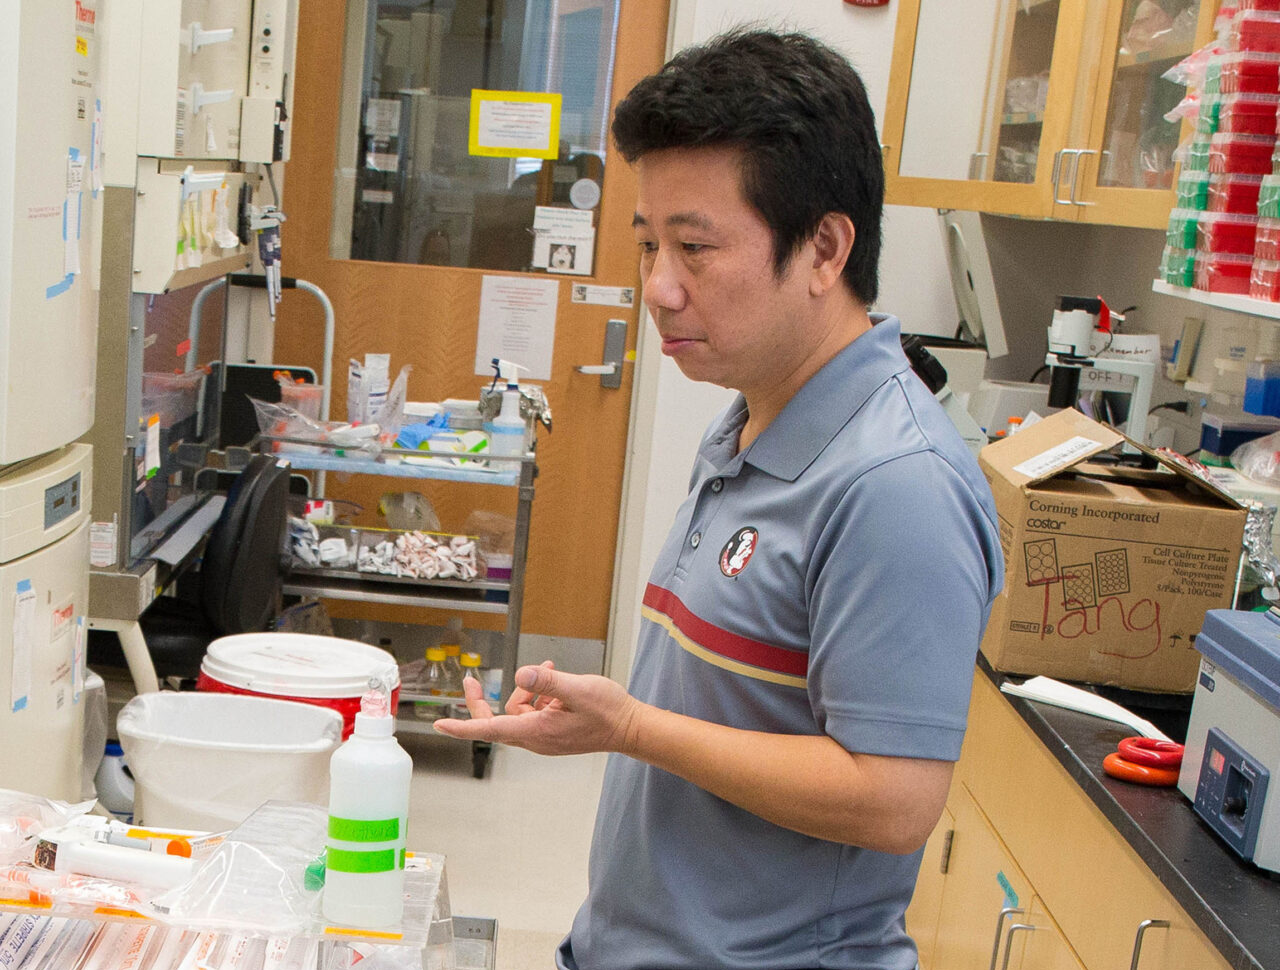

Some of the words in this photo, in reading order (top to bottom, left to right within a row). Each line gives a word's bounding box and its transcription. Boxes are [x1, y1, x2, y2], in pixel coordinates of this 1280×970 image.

[1088, 371, 1112, 383] OFF
[1029, 500, 1078, 518] Corning
[1082, 505, 1160, 525] Incorporated
[1027, 518, 1066, 531] costar
[1153, 547, 1170, 557] Cell
[1173, 549, 1205, 560] Culture
[1208, 552, 1229, 563] Plate
[1142, 555, 1166, 566] Tissue
[1168, 558, 1196, 569] Culture
[1199, 561, 1227, 572] Treated
[1173, 567, 1225, 581] Nonpyrogenic
[1181, 577, 1224, 590] Polystyrene
[1026, 574, 1161, 660] Tang
[9, 918, 36, 953] STRIPETTE
